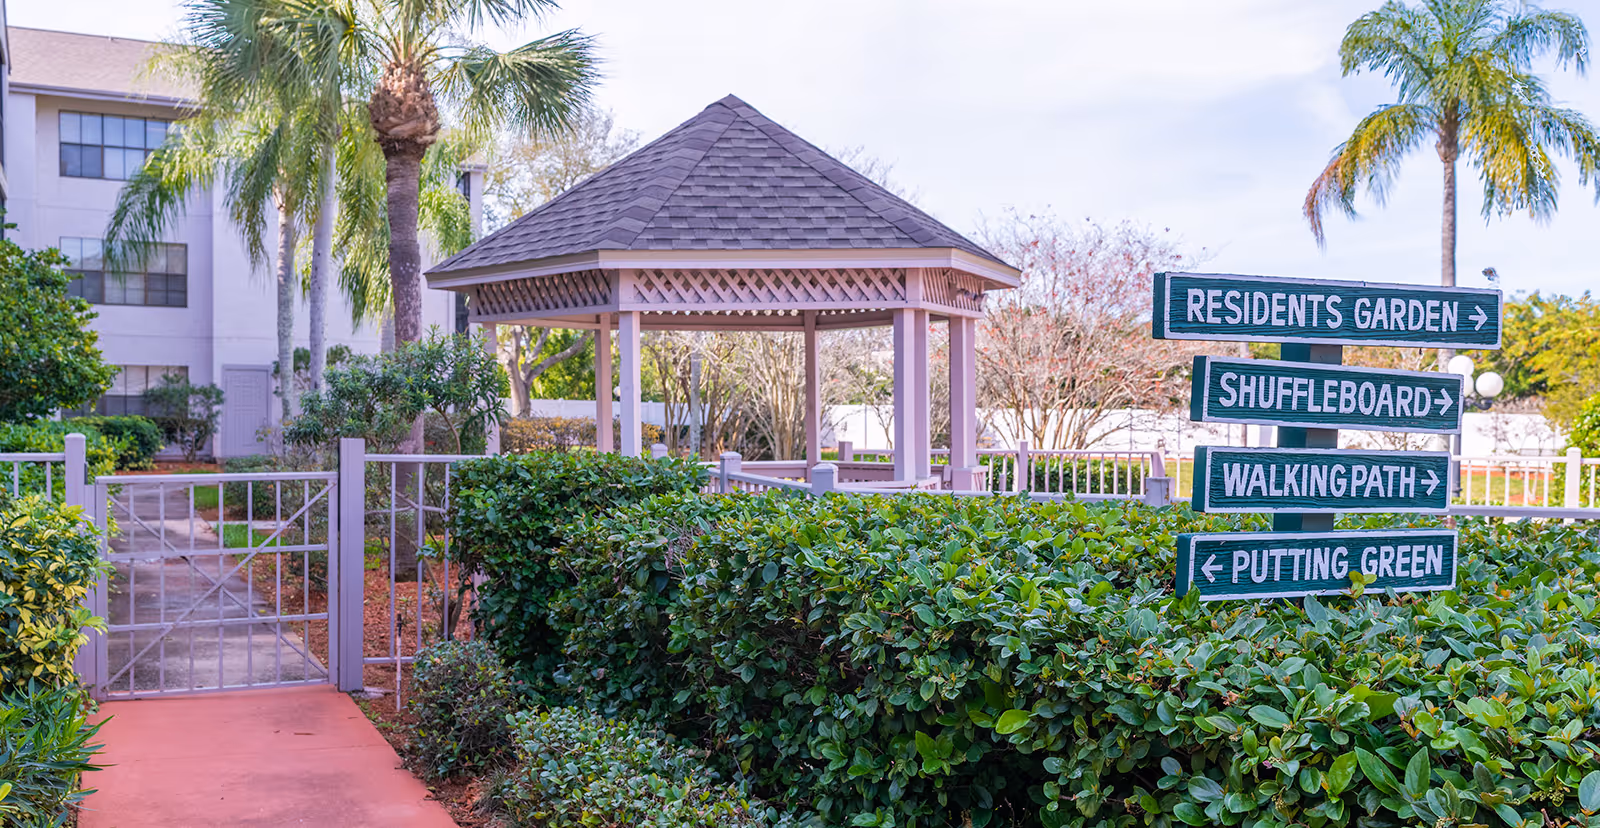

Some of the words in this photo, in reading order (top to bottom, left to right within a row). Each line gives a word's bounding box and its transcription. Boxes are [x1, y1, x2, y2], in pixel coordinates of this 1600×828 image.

[1187, 288, 1343, 330] RESIDENTS
[1354, 297, 1458, 332] GARDEN
[1218, 372, 1432, 417] SHUFFLEBOARD
[1223, 463, 1347, 498] WALKING
[1350, 465, 1415, 498] PATH
[1232, 546, 1348, 583] PUTTING
[1361, 544, 1443, 578] GREEN
